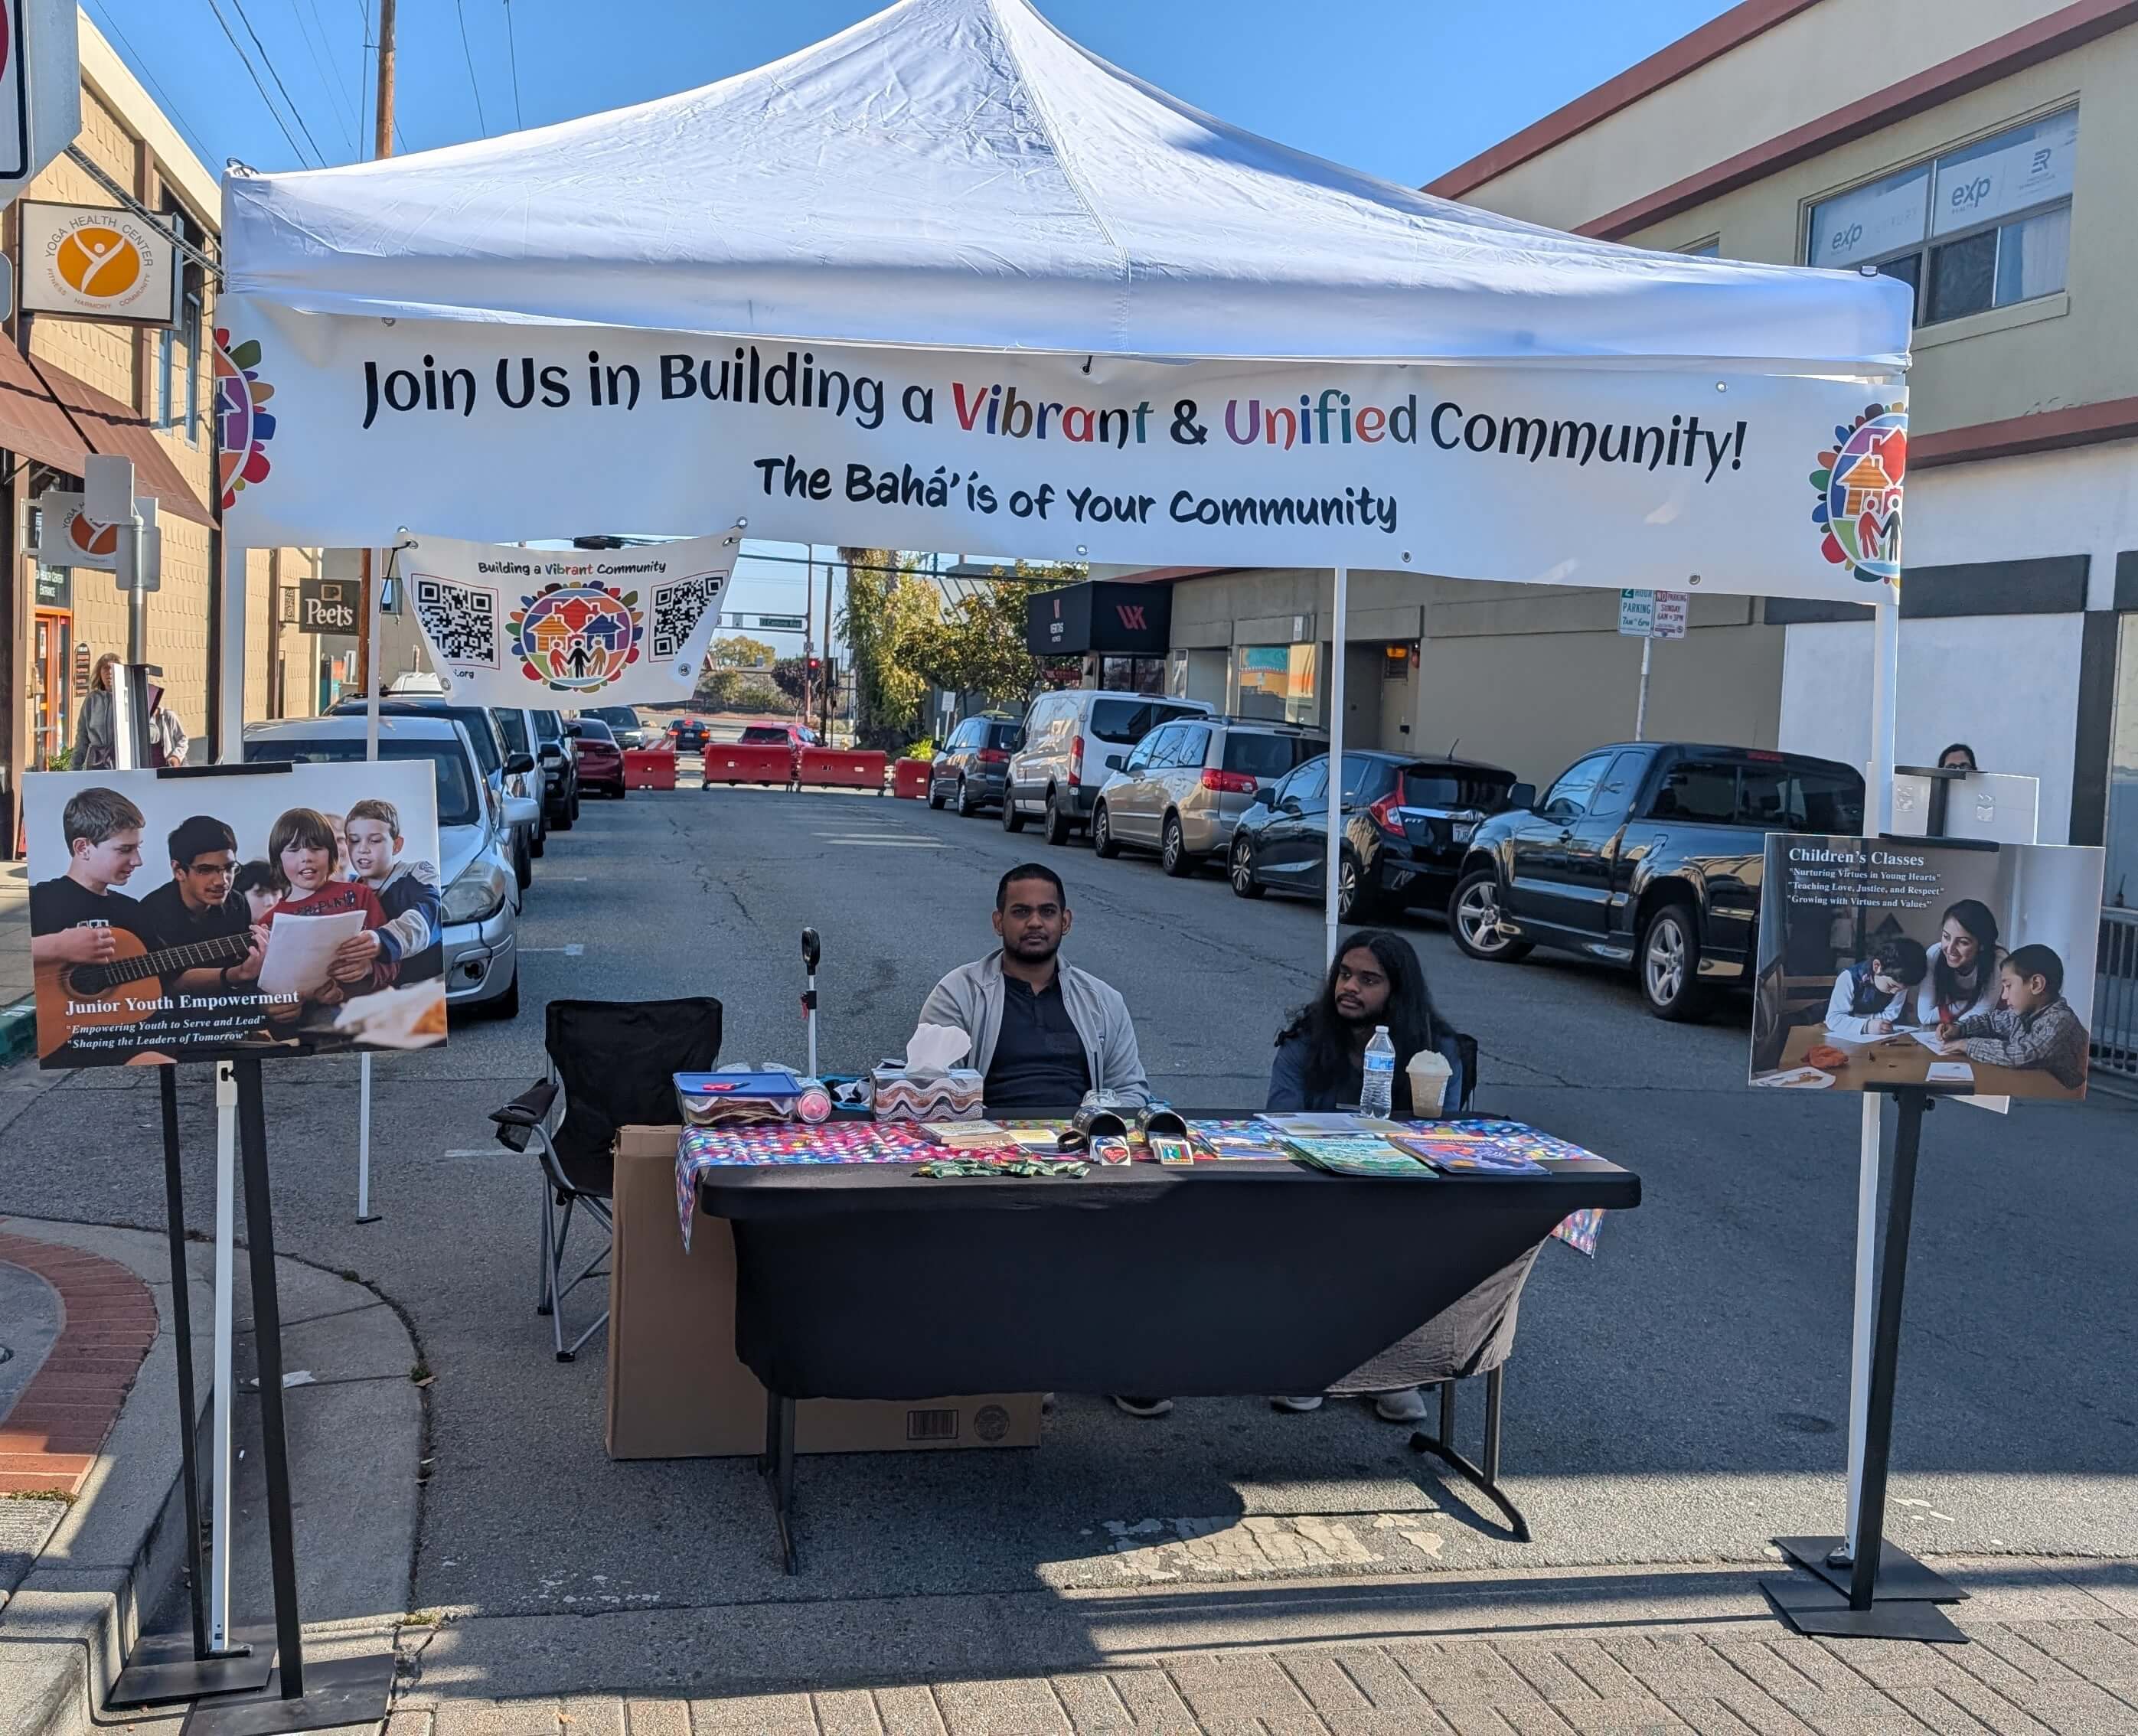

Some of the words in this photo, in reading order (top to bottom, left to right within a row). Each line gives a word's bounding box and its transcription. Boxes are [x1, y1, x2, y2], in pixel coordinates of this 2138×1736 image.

[44, 228, 68, 258] YOGA
[69, 215, 117, 230] HEALTH
[122, 224, 154, 267] CENTER
[47, 268, 67, 296] FITNESS
[74, 298, 111, 310] HARMONY
[119, 273, 151, 307] COMMUNITY
[363, 354, 475, 429] Join
[496, 357, 571, 410] Us
[588, 351, 641, 411] in
[660, 346, 884, 429] Building
[903, 387, 934, 424] a
[951, 382, 1154, 450] Vibrant
[1169, 400, 1208, 445] &
[1225, 389, 1416, 452] Unified
[1431, 402, 1748, 484] Community!
[754, 454, 831, 502] The
[1008, 484, 1055, 520] of
[1068, 488, 1156, 524] Your
[1169, 487, 1397, 534] Community
[62, 508, 79, 529] YOGA
[478, 562, 530, 576] Building
[534, 565, 541, 574] a
[545, 563, 593, 575] Vibrant
[597, 561, 667, 575] Community
[1657, 591, 1666, 602] NO
[1623, 602, 1650, 614] PARKING
[1638, 618, 1650, 626] 6PM
[1789, 848, 1866, 864] Children's
[1871, 851, 1924, 866] Classes
[1789, 868, 1836, 879] "Nurturing
[1839, 868, 1868, 879] Virtues
[1870, 870, 1879, 879] in
[1881, 872, 1906, 881] Young
[1908, 873, 1941, 882] Hearts"
[1788, 881, 1830, 892] "Teaching
[1832, 883, 1855, 892] Love,
[1890, 886, 1906, 894] and
[1908, 886, 1944, 896] Respect"
[1787, 895, 1827, 906] "Growing
[1830, 896, 1848, 906] with
[1851, 898, 1880, 906] Virtues
[1882, 898, 1898, 907] and
[65, 1000, 119, 1016] Junior
[124, 997, 174, 1012] Youth
[179, 990, 299, 1011] Empowerment
[67, 1023, 135, 1036] "Empowering
[139, 1021, 168, 1032] Youth
[171, 1021, 180, 1030] to
[183, 1019, 211, 1028] Serve
[214, 1016, 233, 1026] and
[235, 1015, 266, 1025] Lead"
[67, 1038, 115, 1049] "Shaping
[118, 1036, 133, 1046] the
[137, 1034, 176, 1046] Leaders
[179, 1033, 191, 1045] of
[192, 1030, 249, 1042] Tomorrow"
